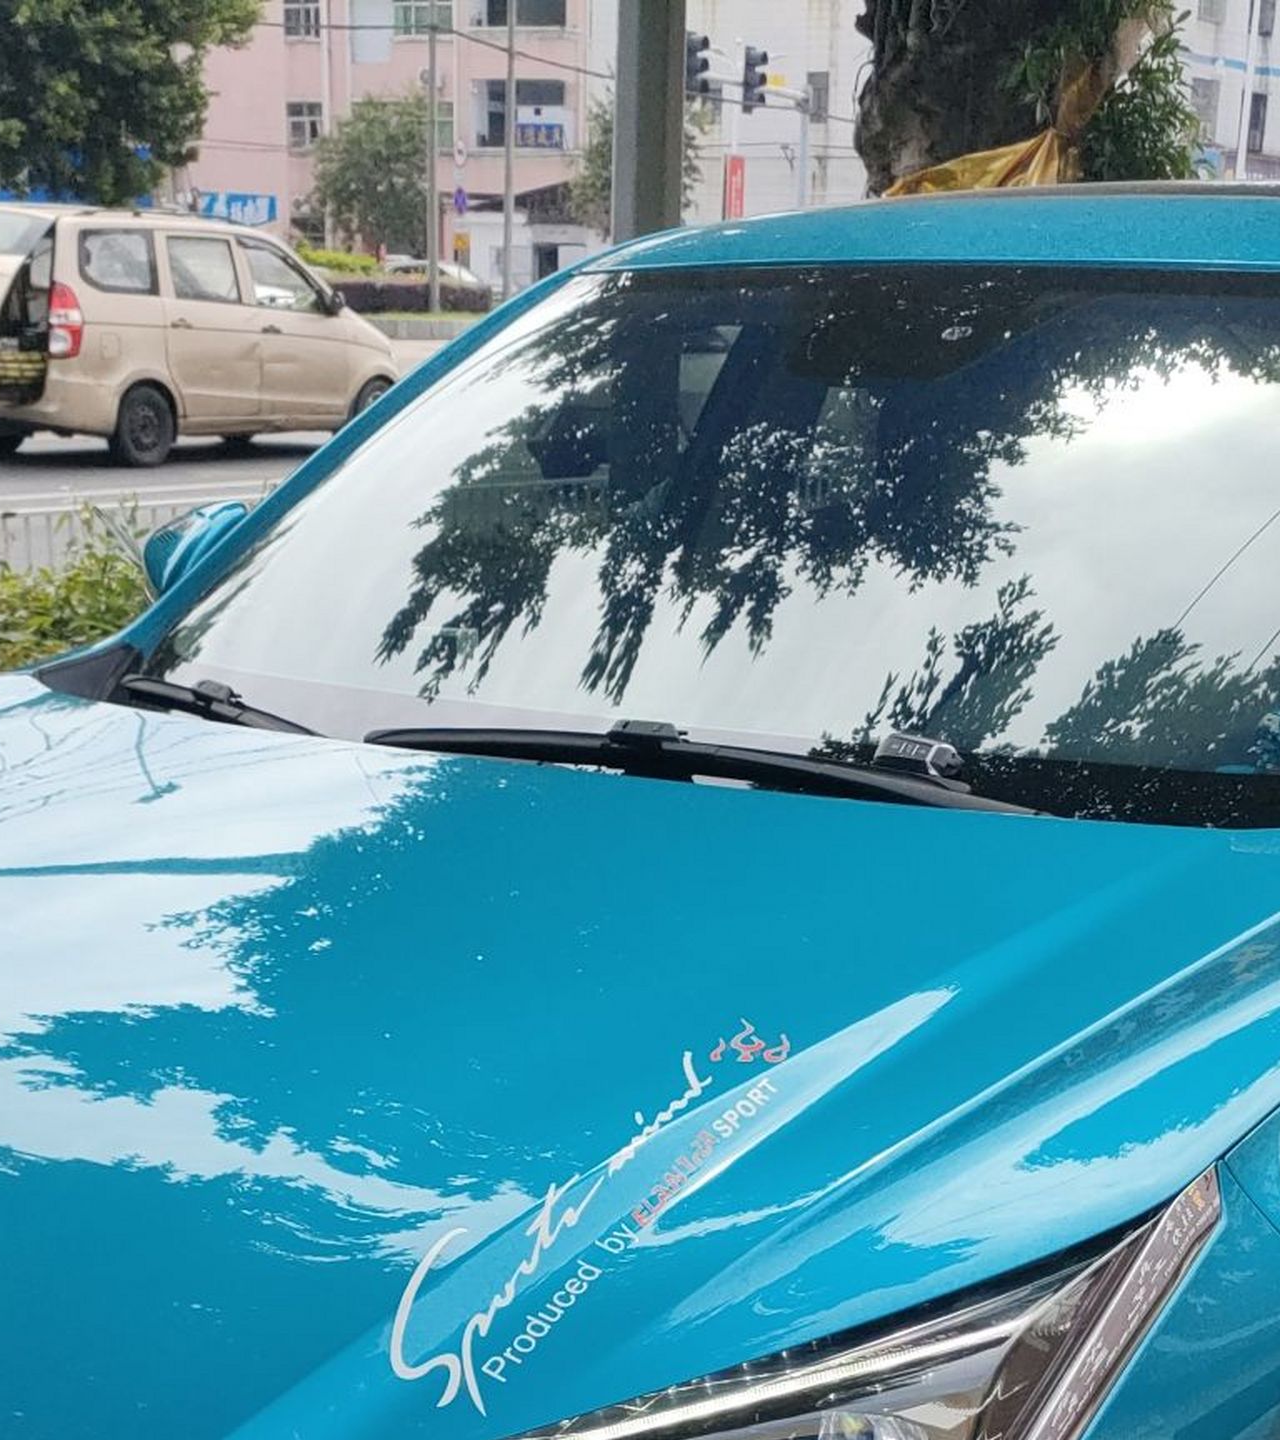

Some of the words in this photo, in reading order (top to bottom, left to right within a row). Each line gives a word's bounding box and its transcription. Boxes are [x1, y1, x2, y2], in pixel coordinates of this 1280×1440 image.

[480, 1259, 603, 1384] Produced
[594, 1221, 640, 1256] by
[711, 1077, 781, 1142] SPORT
